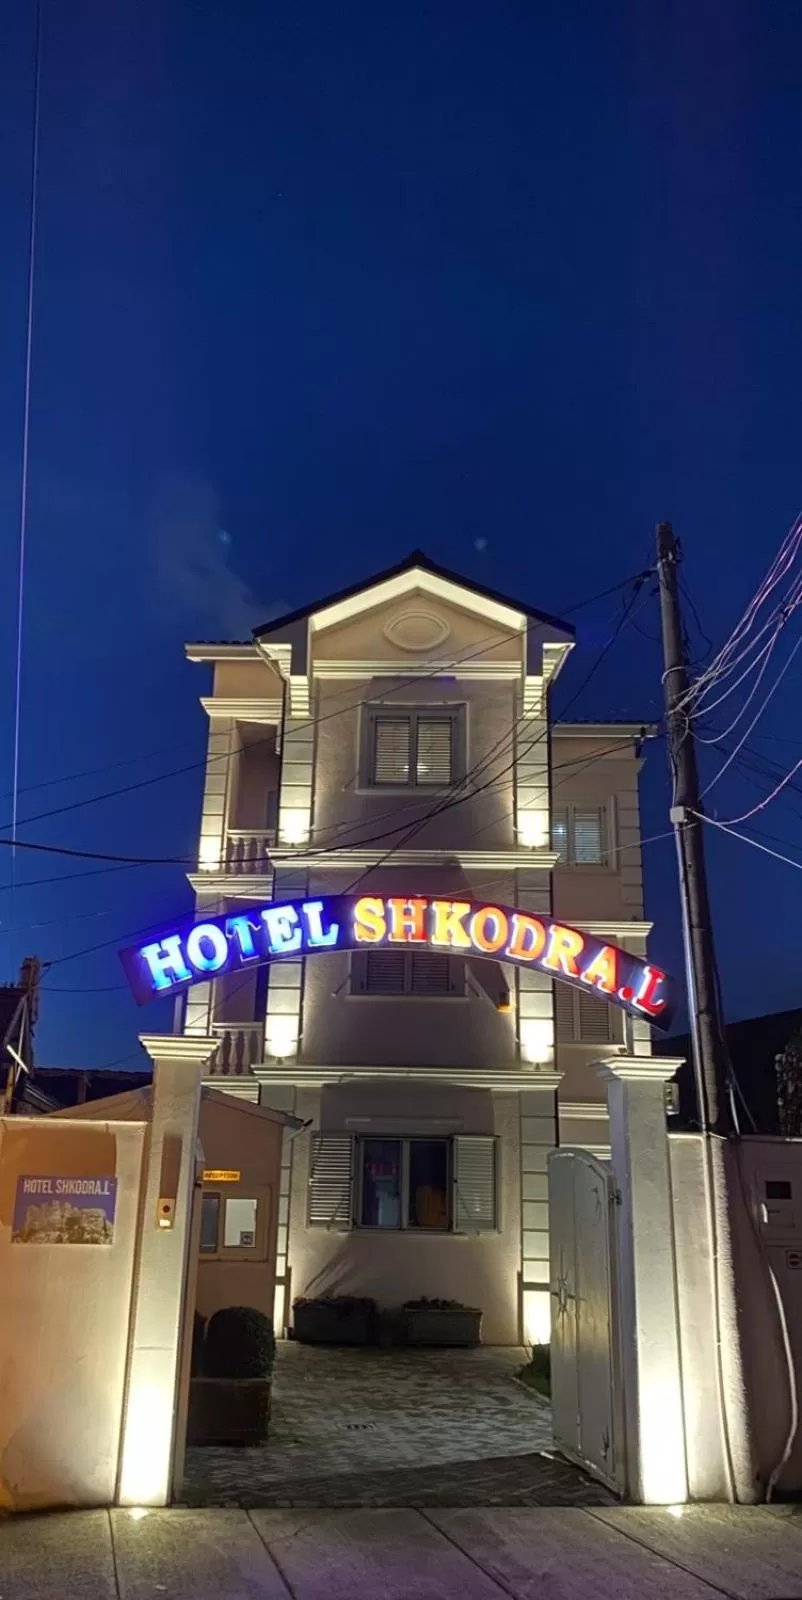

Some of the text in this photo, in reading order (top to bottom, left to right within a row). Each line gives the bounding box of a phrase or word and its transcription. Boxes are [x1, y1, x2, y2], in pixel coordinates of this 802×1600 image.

[140, 897, 666, 1016] HOTEL SHKODRA.L
[23, 1179, 53, 1194] HOTEL
